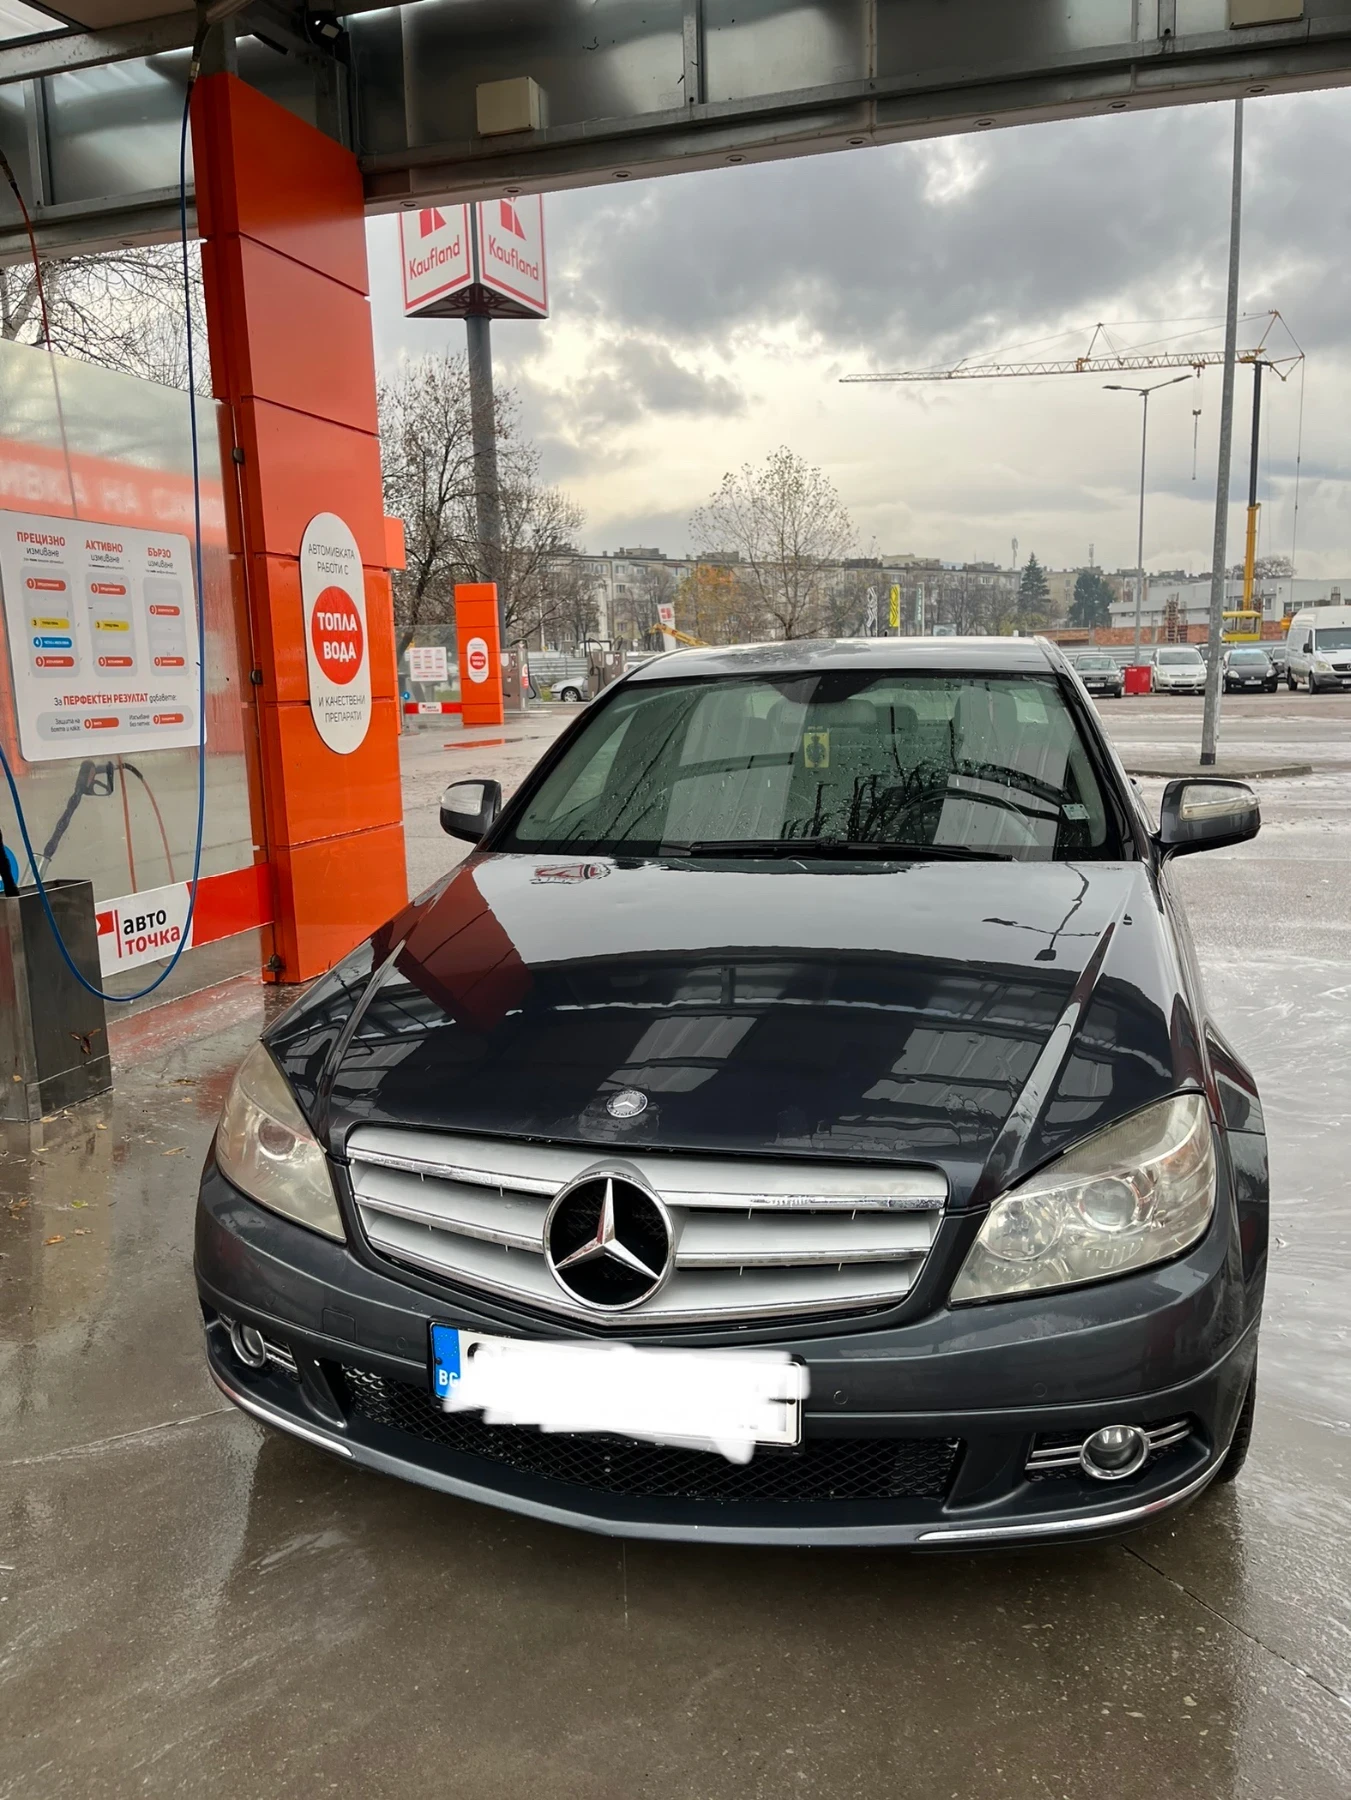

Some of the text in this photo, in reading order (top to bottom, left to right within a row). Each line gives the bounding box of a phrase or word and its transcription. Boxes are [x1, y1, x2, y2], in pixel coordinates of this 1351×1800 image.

[409, 234, 460, 280] Kaufland
[488, 235, 539, 280] Kaufland
[17, 531, 66, 547] ПРЕЦИЗНО
[85, 540, 123, 553] АКТИВНО
[26, 547, 60, 558] измиване
[90, 554, 120, 564] измиване
[147, 547, 172, 558] БЪРЗО
[308, 543, 356, 560] АВТОМИВКАТА
[147, 559, 174, 569] измиване
[317, 562, 343, 575] РАБОТИ
[317, 612, 358, 631] ТОПЛА
[323, 641, 357, 662] ВОДА
[54, 697, 63, 707] За
[63, 694, 113, 706] ПЕРФЕКТЕН
[114, 693, 148, 703] РЕЗУЛТАТ
[318, 694, 366, 707] И КАЧЕСТВЕНИ
[325, 711, 362, 723] ПРЕПАРАТИ
[123, 909, 167, 935] авто
[125, 925, 181, 955] точка
[439, 1369, 459, 1387] BG
